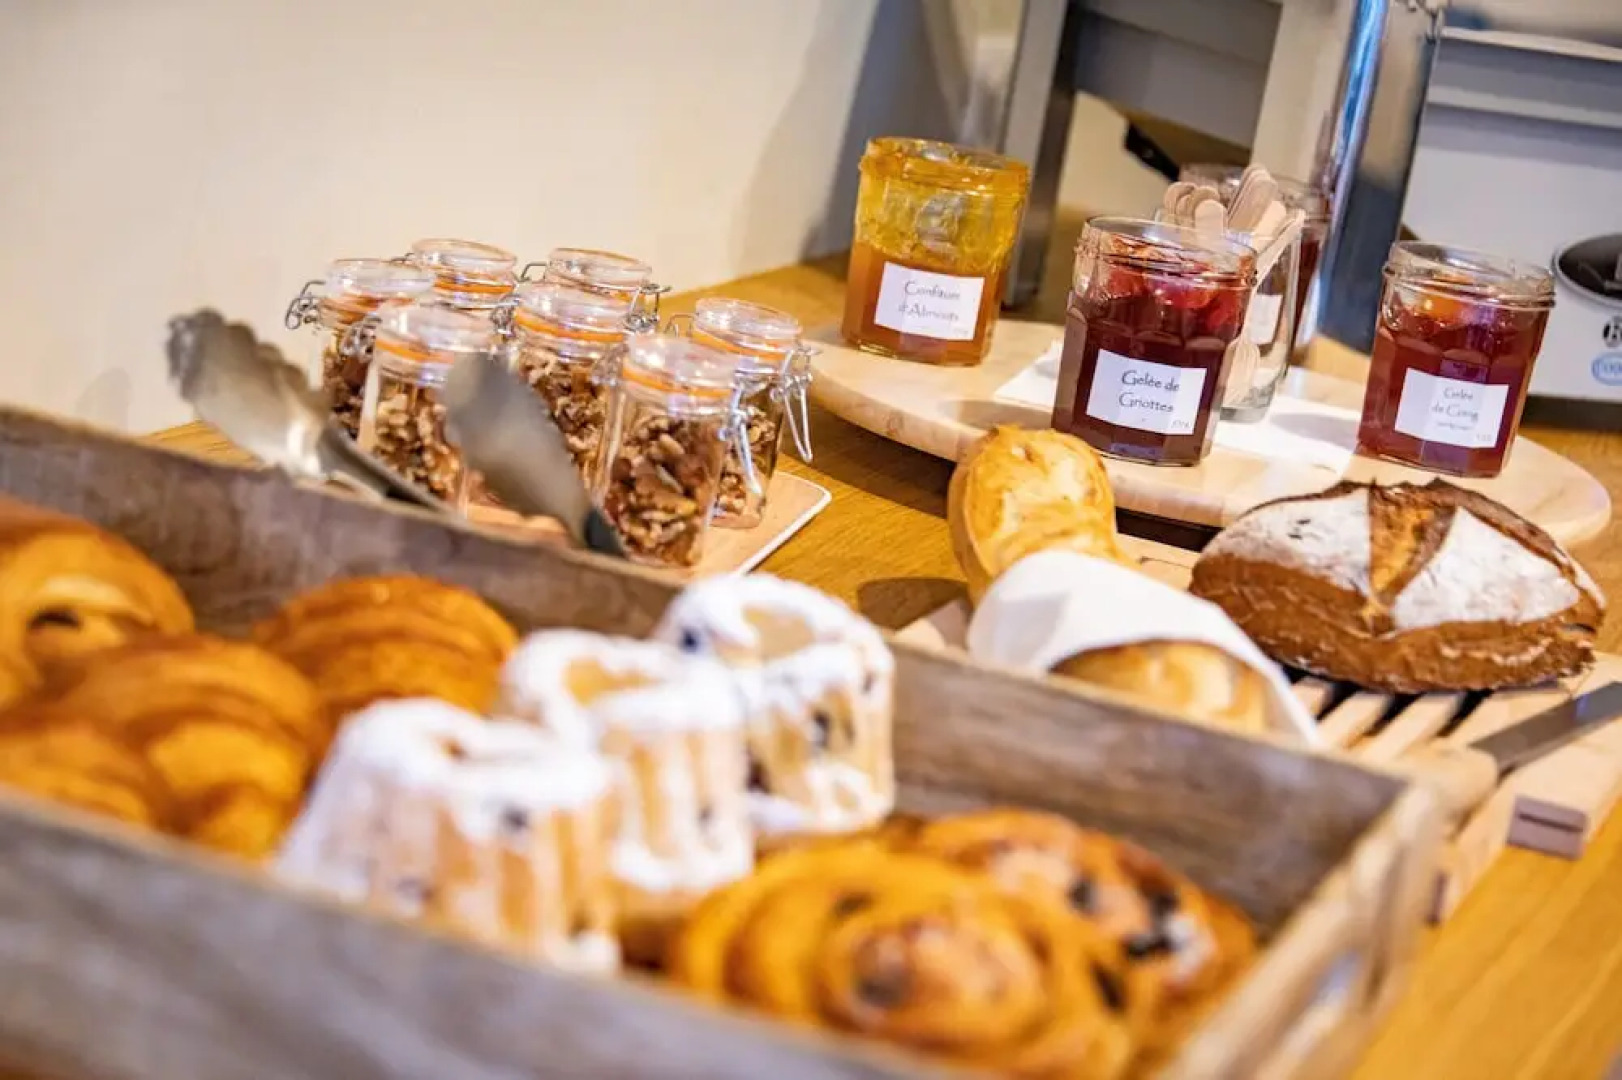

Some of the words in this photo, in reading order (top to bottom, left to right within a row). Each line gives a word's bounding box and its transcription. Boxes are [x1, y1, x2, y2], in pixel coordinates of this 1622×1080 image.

[1121, 369, 1163, 389] Gelée
[1164, 377, 1180, 392] de
[1118, 391, 1174, 413] Griottes
